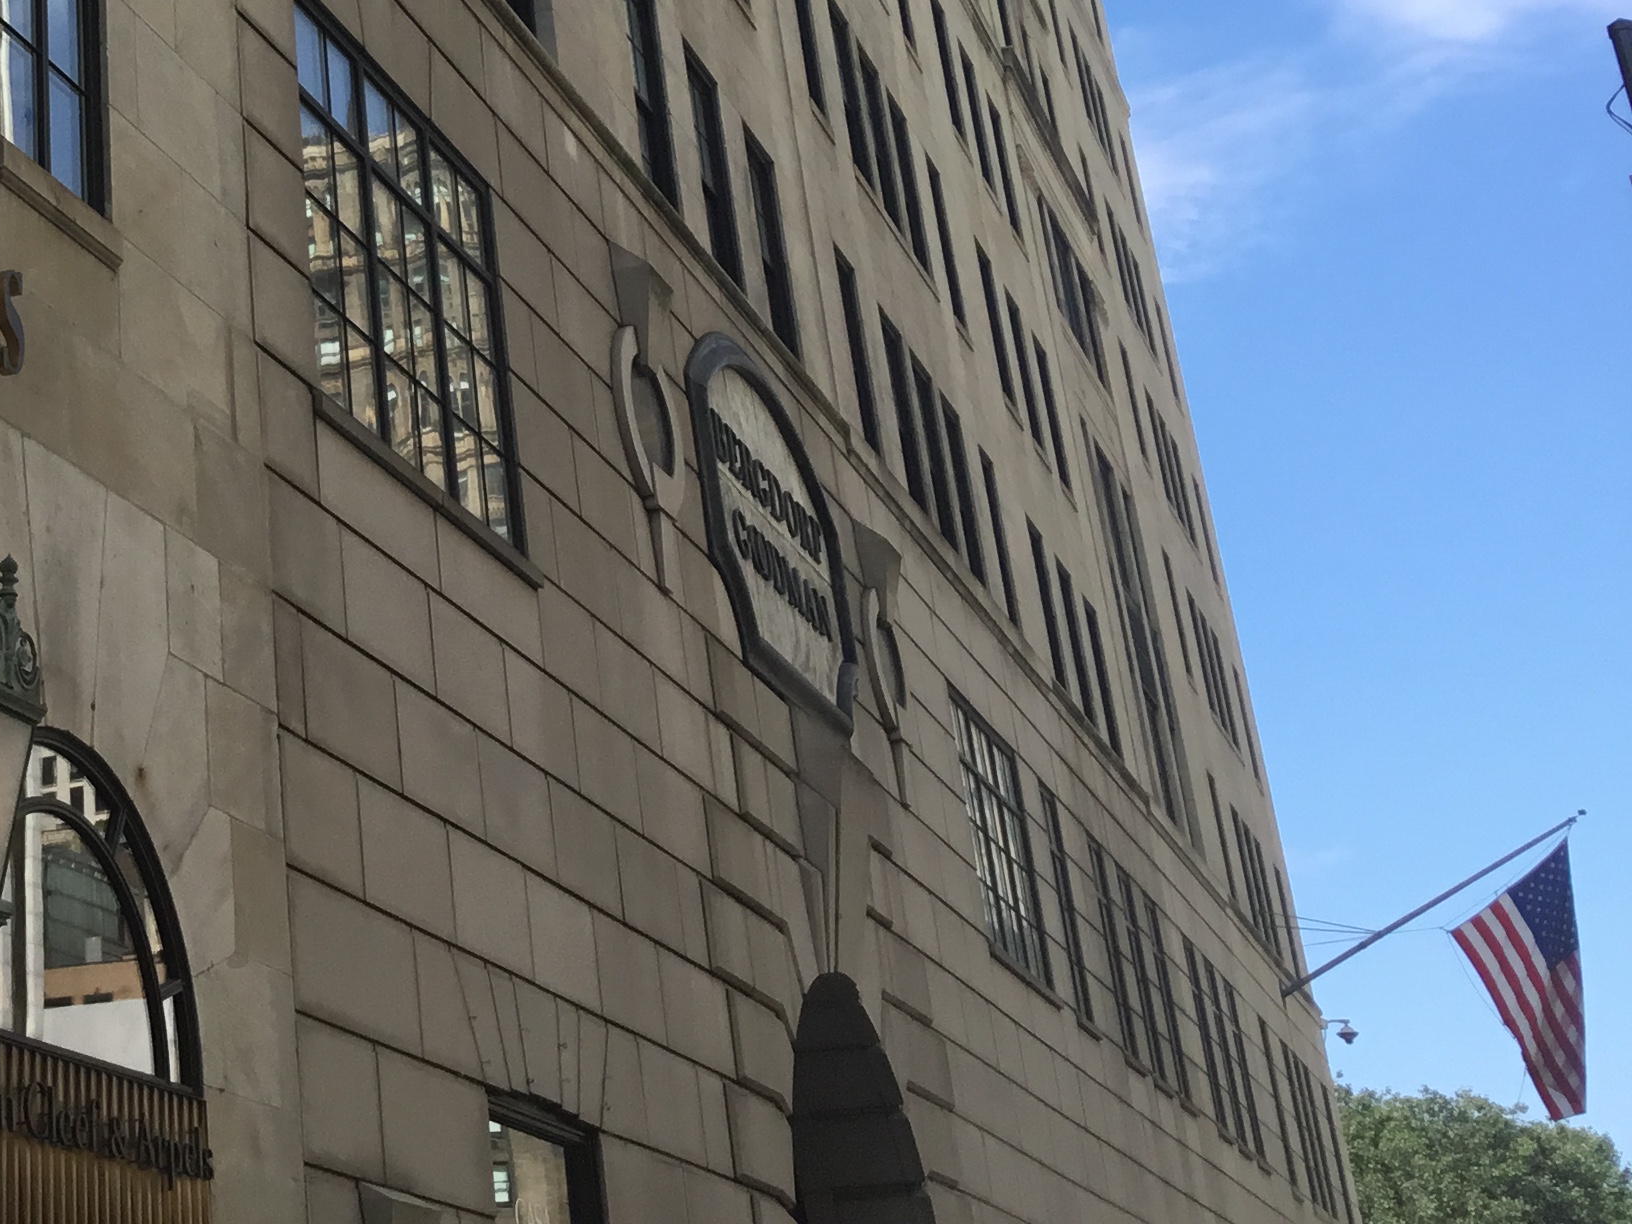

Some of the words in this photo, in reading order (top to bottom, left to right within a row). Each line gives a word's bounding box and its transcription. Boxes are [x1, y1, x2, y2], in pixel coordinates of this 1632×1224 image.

[709, 407, 823, 565] BERGDORF
[732, 507, 834, 643] GOODMAN
[22, 1080, 101, 1153] Cleef
[133, 1115, 214, 1191] Arpels
